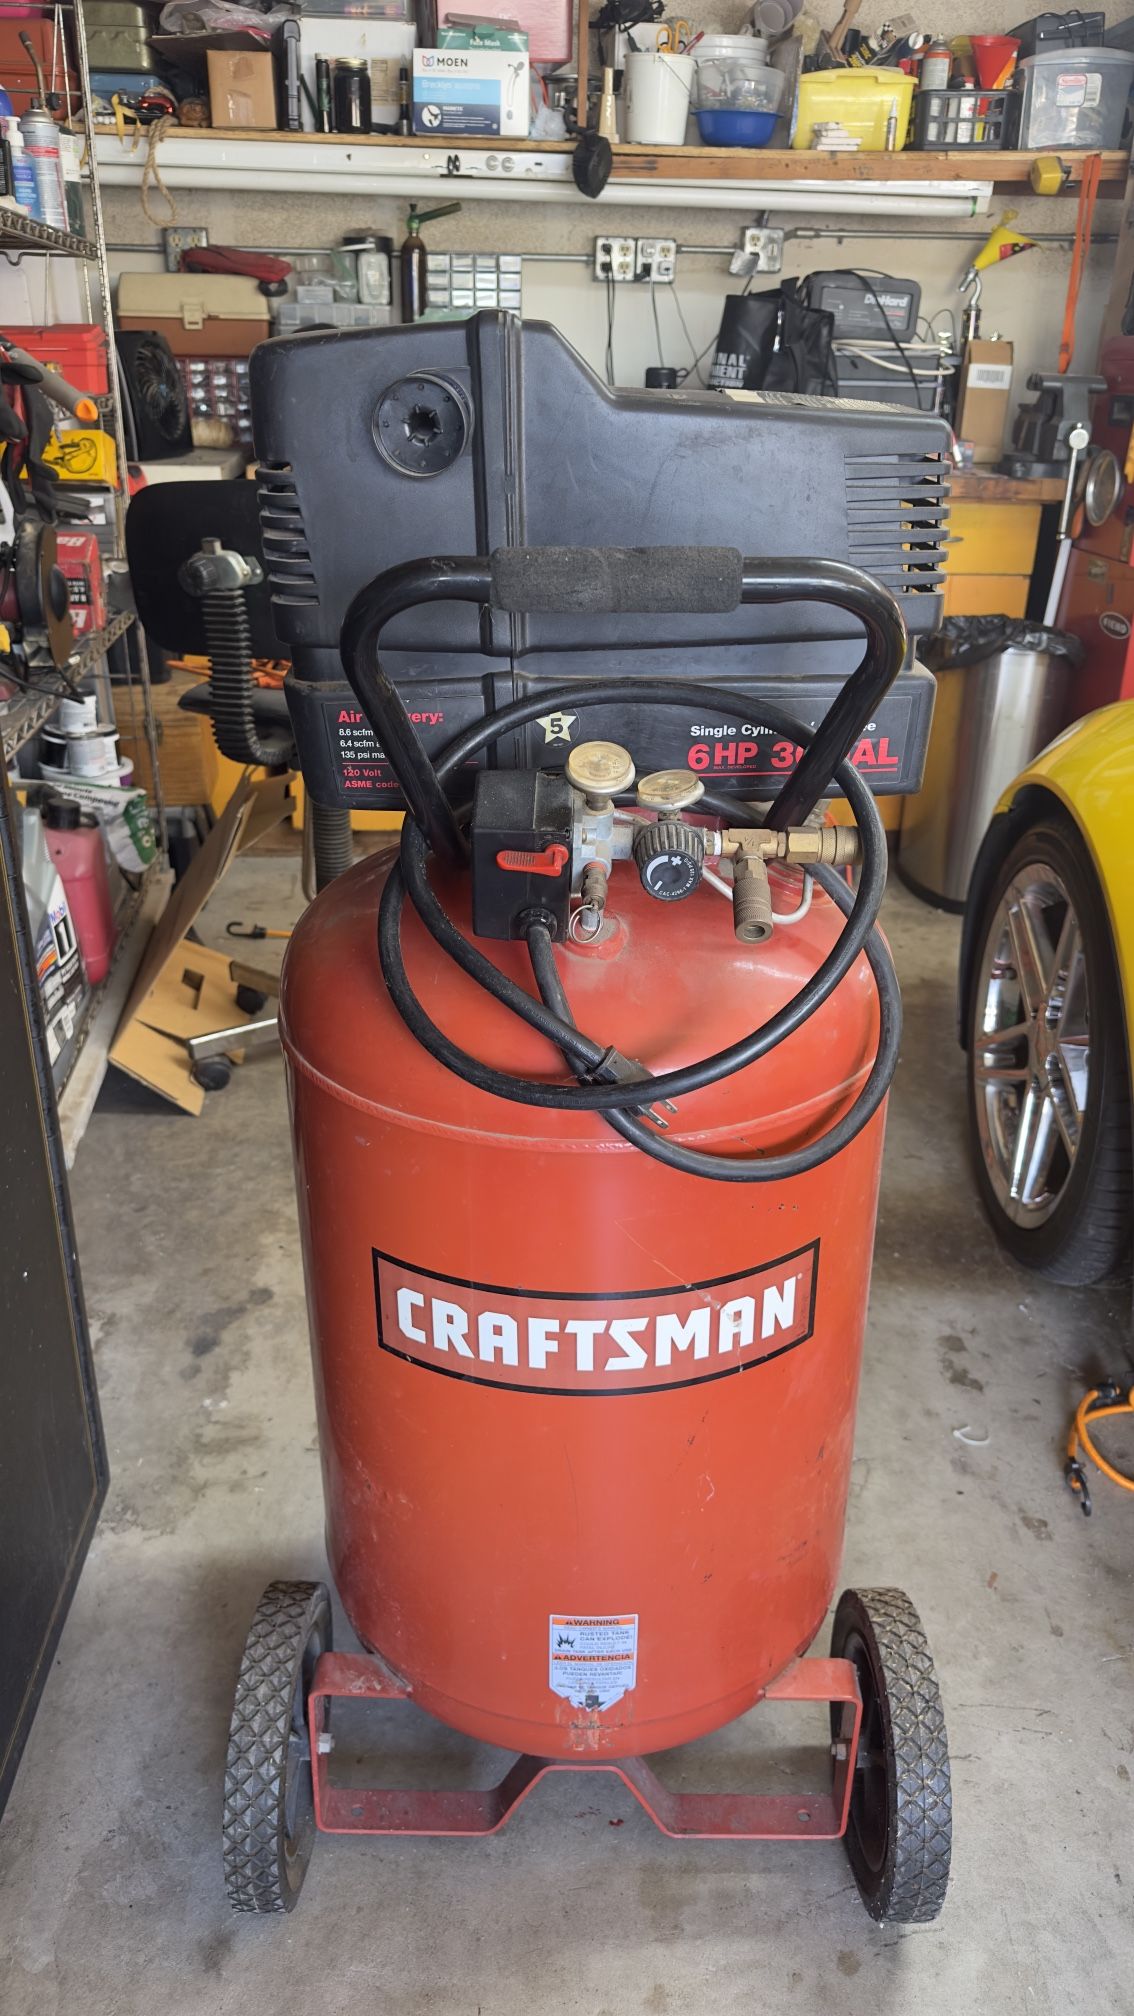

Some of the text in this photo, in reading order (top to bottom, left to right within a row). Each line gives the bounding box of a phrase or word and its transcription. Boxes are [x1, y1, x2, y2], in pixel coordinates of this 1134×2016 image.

[437, 58, 468, 67] MOEN
[338, 710, 363, 723] Air
[550, 717, 563, 734] 5
[338, 728, 374, 736] 8.6 scfm
[690, 725, 737, 738] Single
[340, 740, 352, 748] 6.4
[353, 740, 375, 748] scfm
[341, 751, 355, 759] 135
[357, 751, 370, 760] psi
[848, 737, 899, 766] AL
[343, 769, 382, 777] 120 Volt
[396, 1275, 797, 1371] CRAFTSMAN
